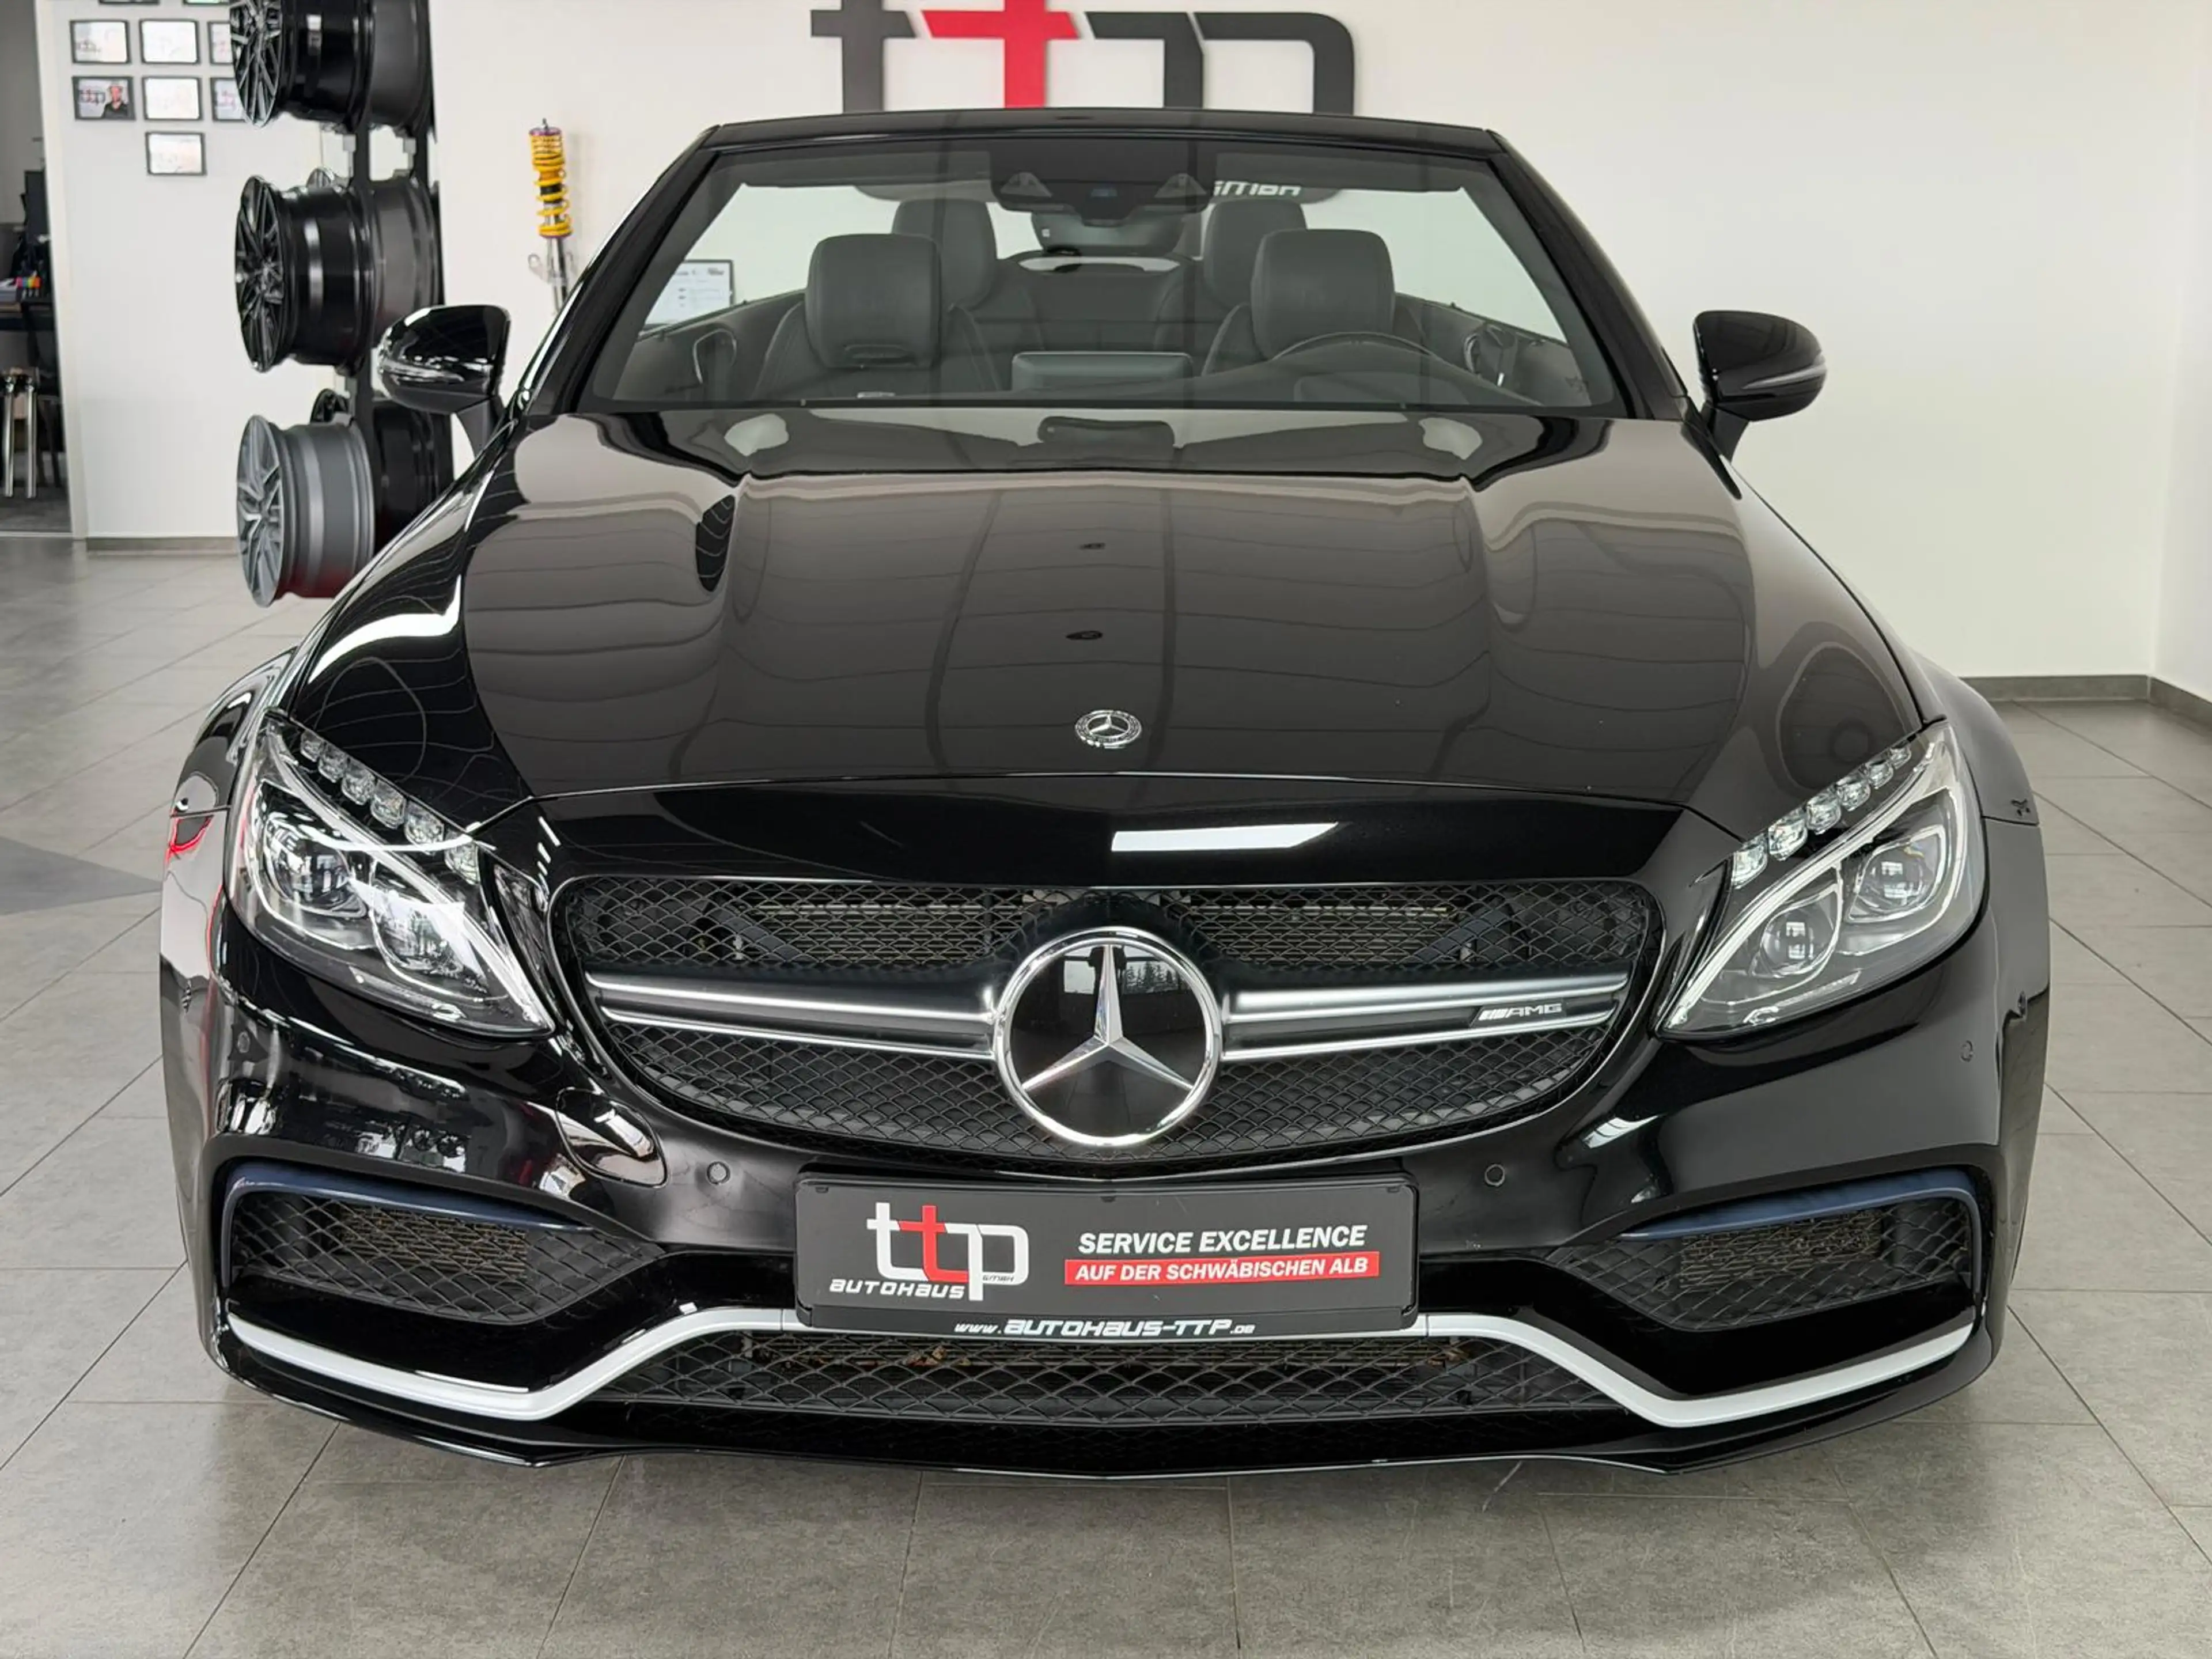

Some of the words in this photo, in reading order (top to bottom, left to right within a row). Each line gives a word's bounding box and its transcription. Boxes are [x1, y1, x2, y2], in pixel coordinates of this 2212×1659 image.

[866, 1202, 1029, 1301] ttp
[1078, 1232, 1194, 1254] SERVICE
[1199, 1225, 1368, 1252] EXCELLENCE
[1075, 1264, 1117, 1280] AUF
[1120, 1264, 1162, 1280] DER
[1165, 1259, 1326, 1280] SCHWÄBISCHEN
[1329, 1257, 1369, 1274] ALB
